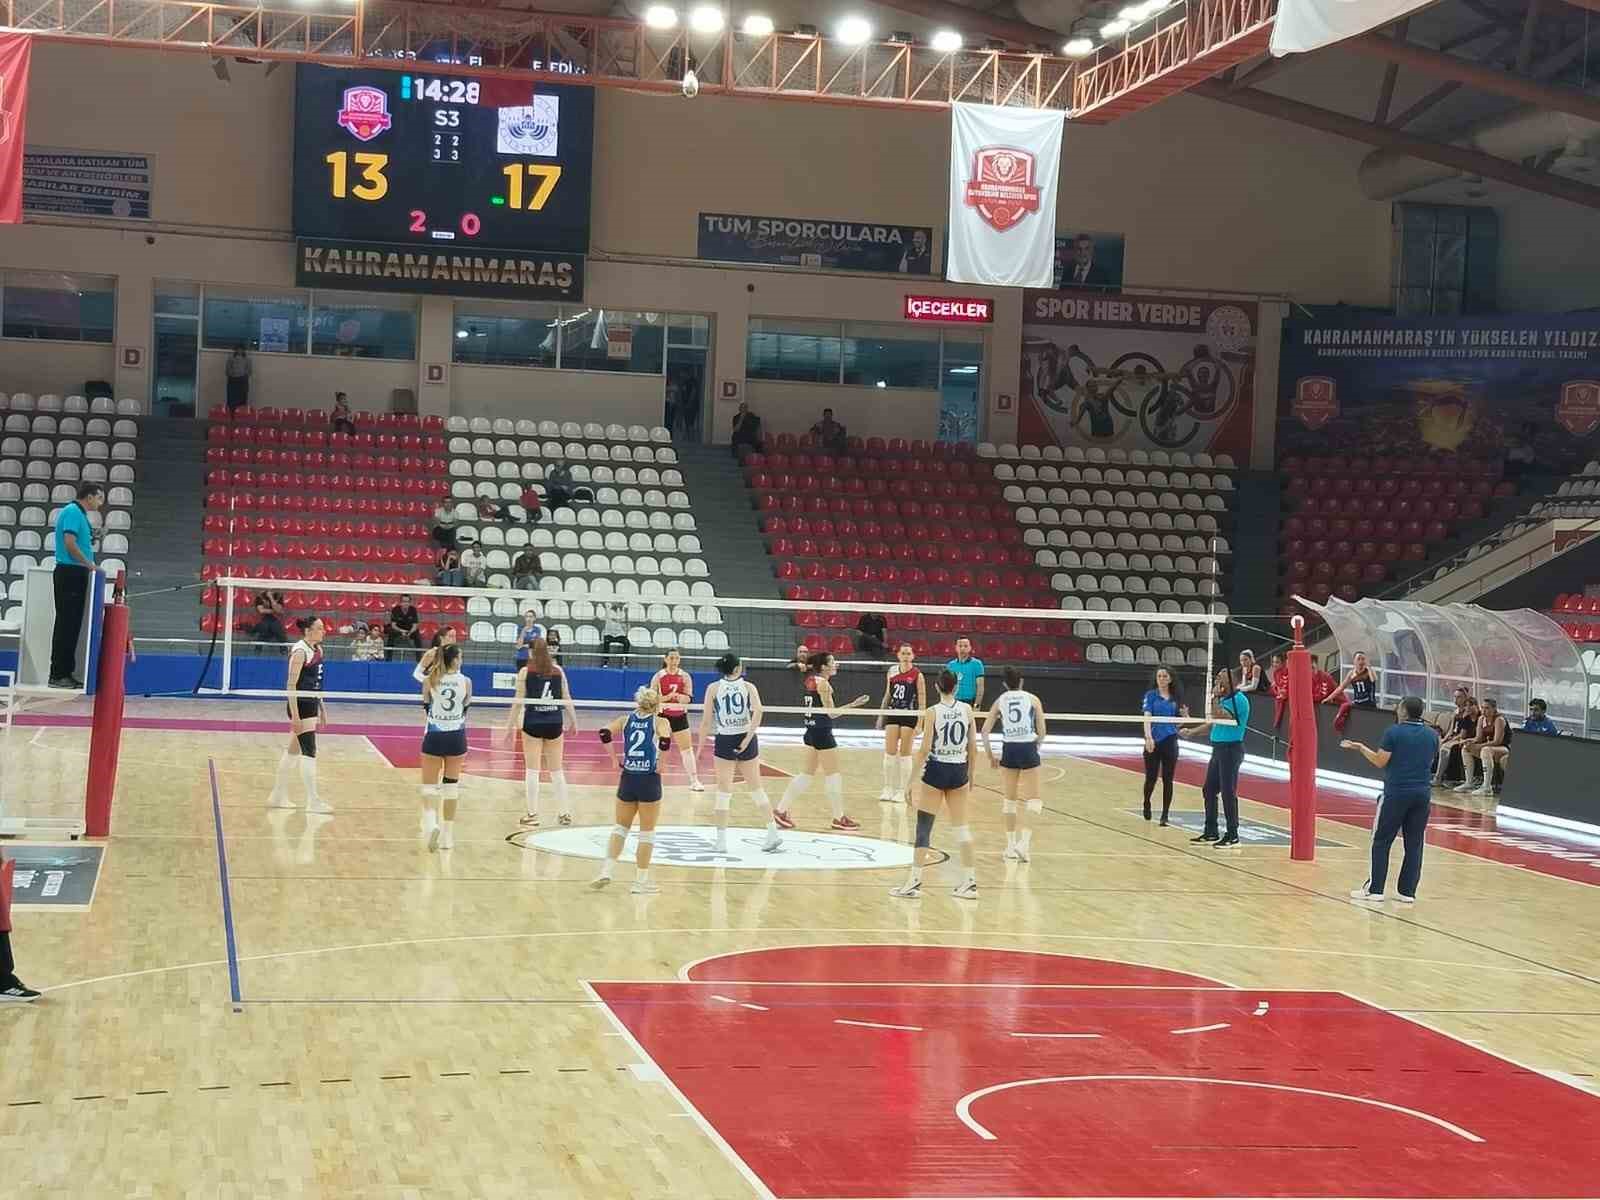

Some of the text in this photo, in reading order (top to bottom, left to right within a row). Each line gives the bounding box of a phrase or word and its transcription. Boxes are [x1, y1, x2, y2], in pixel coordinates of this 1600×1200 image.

[415, 79, 480, 104] 14:28
[434, 110, 460, 126] S3
[123, 158, 145, 168] TÜM
[325, 151, 389, 201] 13
[502, 163, 563, 211] 17
[408, 209, 481, 235] 2 0
[757, 219, 903, 244] SPORCULARA
[303, 246, 574, 294] KAHRAMANMARAŞ
[907, 298, 988, 318] İÇECEKLER
[1036, 297, 1201, 326] SPOR HER YERDE
[1303, 328, 1600, 347] KAHRAMANMARAŞ'IN YÜKSELEN YILDIZ
[440, 688, 457, 711] 3
[893, 683, 906, 699] 28
[722, 692, 744, 716] 19
[1008, 702, 1022, 723] 5
[628, 730, 646, 757] 2
[940, 721, 965, 746] 10
